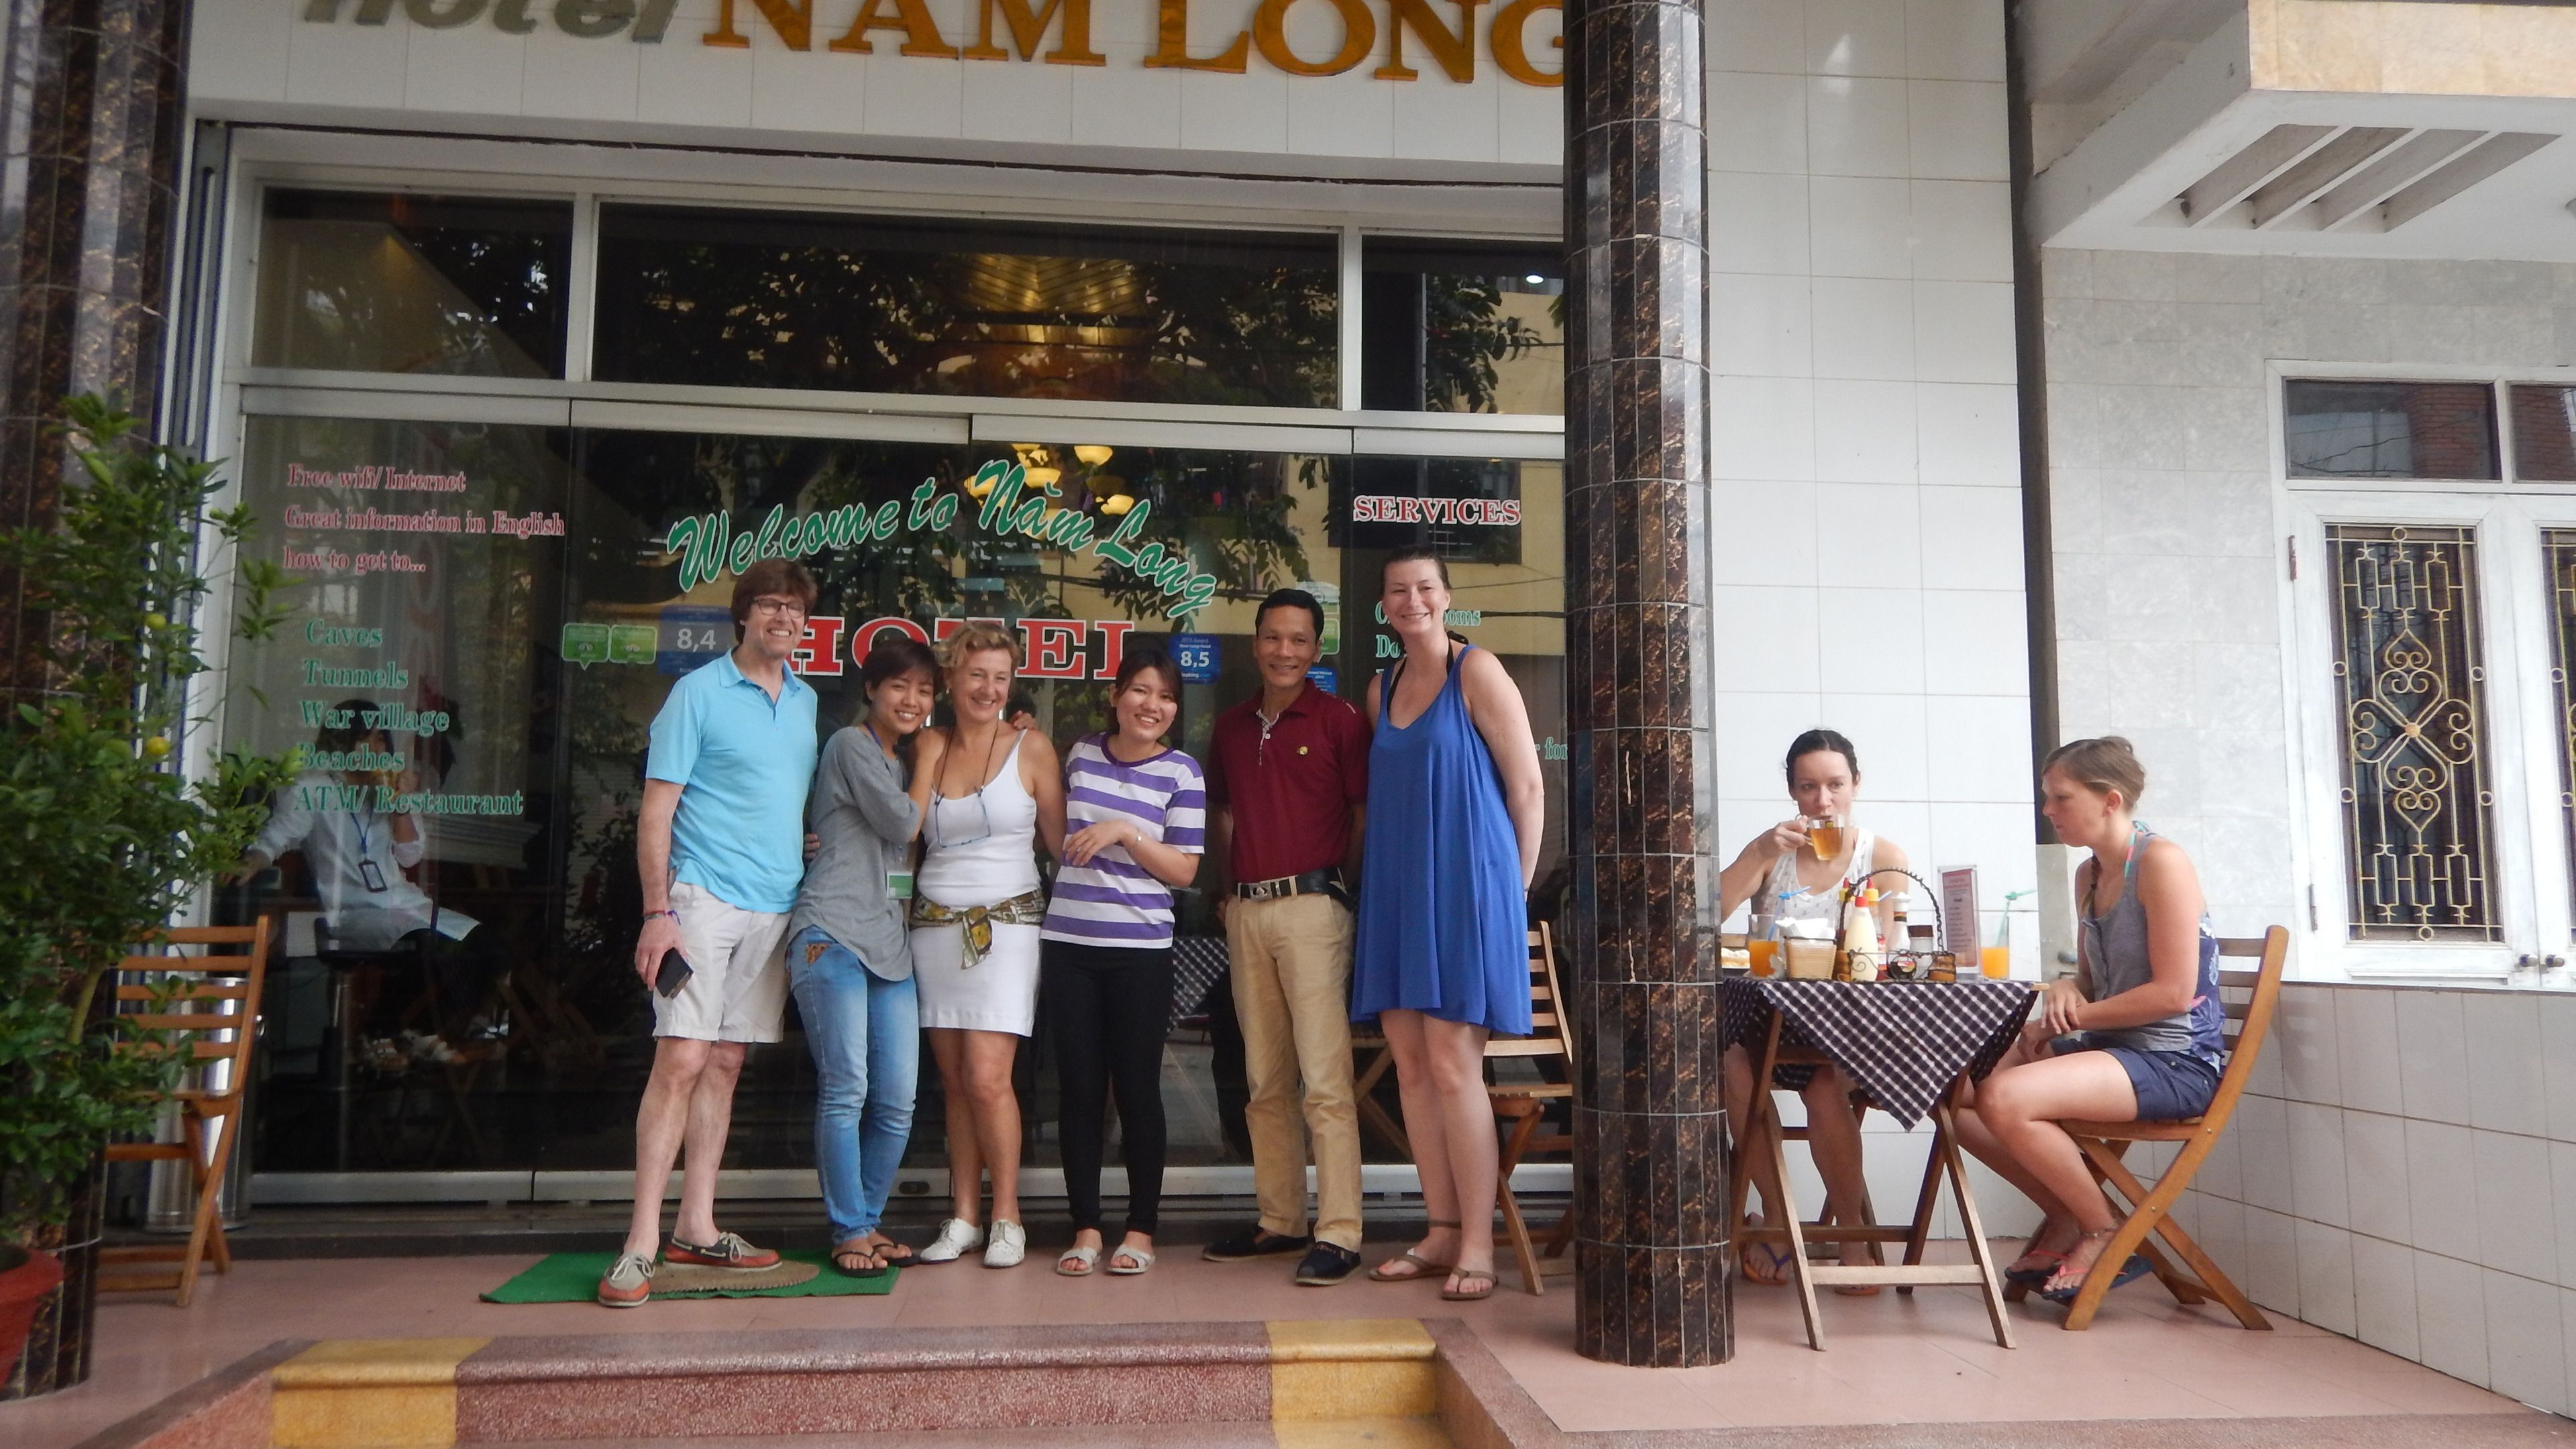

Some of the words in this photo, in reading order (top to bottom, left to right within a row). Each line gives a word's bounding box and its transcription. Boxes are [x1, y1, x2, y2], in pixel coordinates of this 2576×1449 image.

[702, 0, 1107, 66] NAM
[1144, 0, 1564, 87] LONG
[287, 463, 333, 487] Free
[338, 466, 383, 490] wifi/
[385, 467, 466, 492] Internet
[284, 505, 341, 529] Great
[345, 506, 461, 533] information
[465, 510, 486, 533] in
[491, 510, 566, 539] English
[1353, 495, 1521, 526] SERVICES
[283, 545, 323, 570] how
[329, 549, 350, 570] to
[356, 550, 386, 574] get
[391, 550, 427, 572] to...
[666, 500, 900, 593] Welcome
[907, 476, 959, 532] to
[1093, 498, 1217, 619] Long
[306, 619, 383, 647] Caves
[677, 628, 716, 653] 8,4
[301, 658, 409, 690] Tunnels
[1180, 651, 1210, 668] 8,5
[300, 700, 355, 730] War
[361, 702, 450, 738] village
[299, 742, 406, 771] Beaches
[294, 784, 368, 814] ATM/
[374, 785, 524, 816] Restaurant
